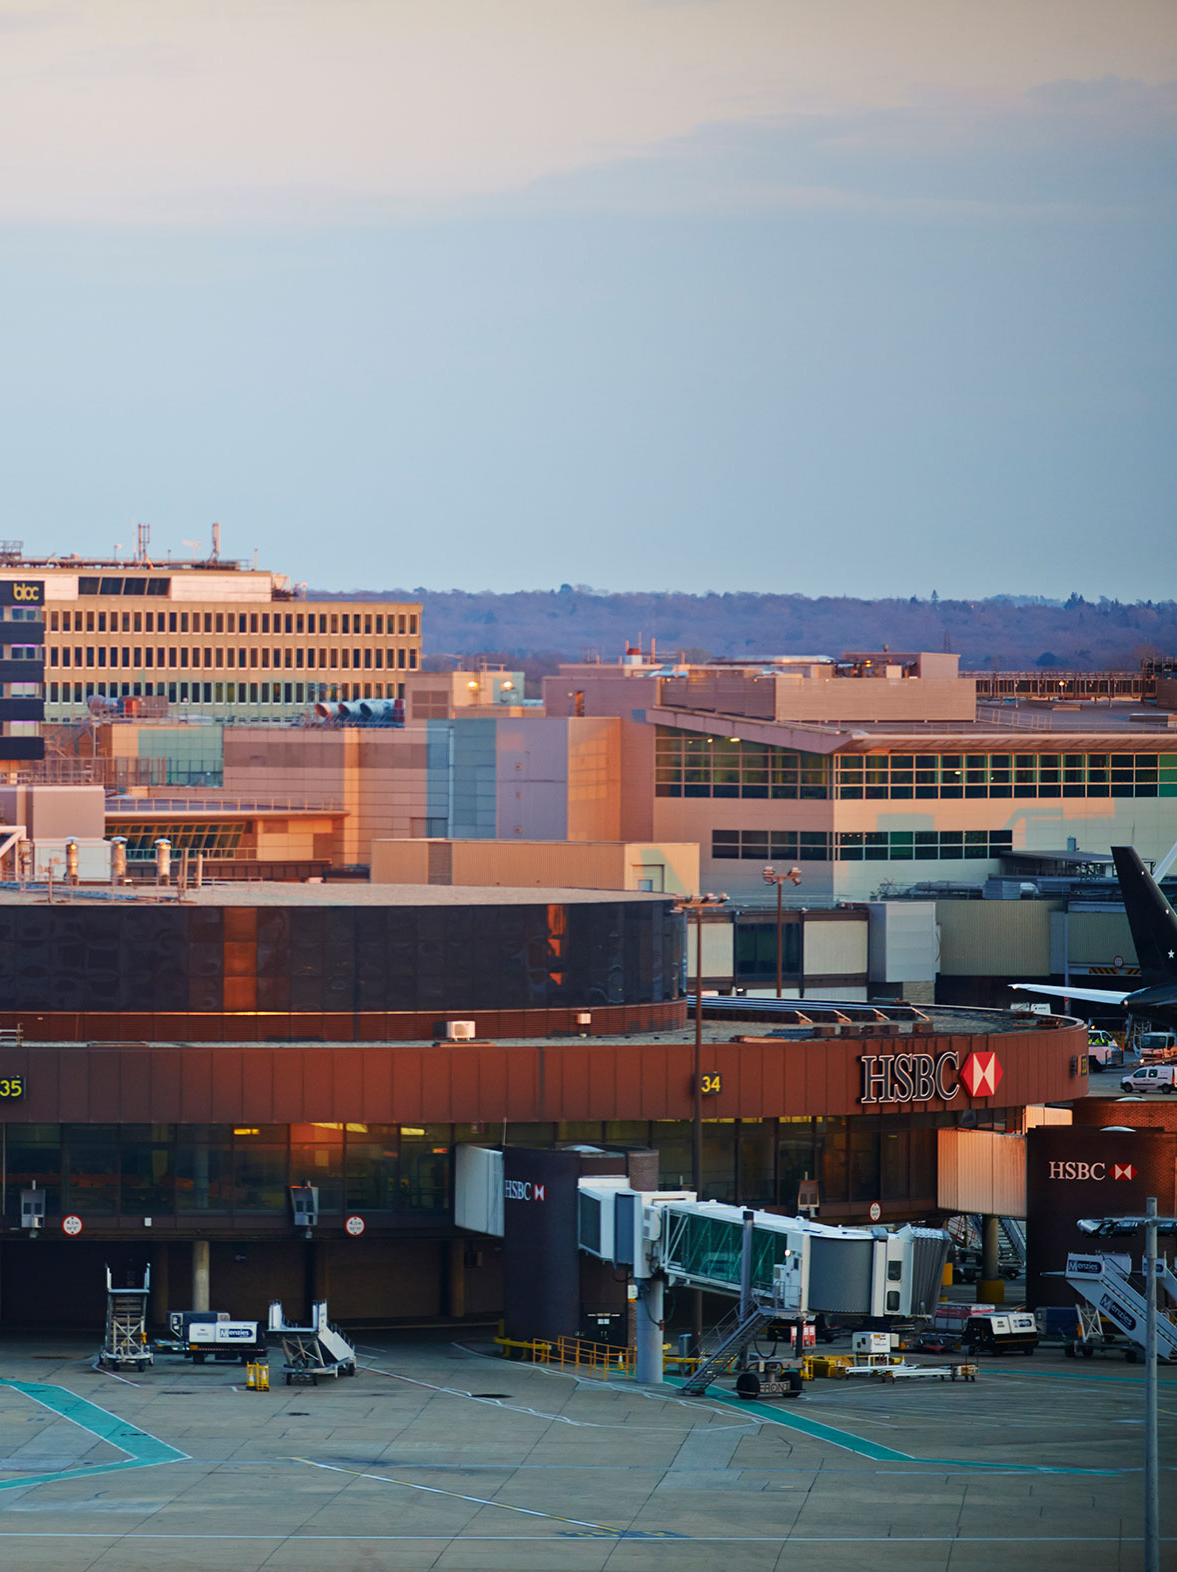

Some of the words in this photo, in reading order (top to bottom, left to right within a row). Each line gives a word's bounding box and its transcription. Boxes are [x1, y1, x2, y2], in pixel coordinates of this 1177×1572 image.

[13, 583, 39, 600] bloc
[701, 1075, 721, 1092] 34
[861, 1051, 960, 1103] HSBC
[0, 1080, 23, 1097] 35
[1048, 1161, 1106, 1181] HSBC
[504, 1180, 532, 1201] HSBC
[1068, 1260, 1099, 1272] Menzies
[1100, 1293, 1133, 1327] Menzies
[220, 1329, 250, 1338] Menzies
[760, 1383, 791, 1392] FRONT
